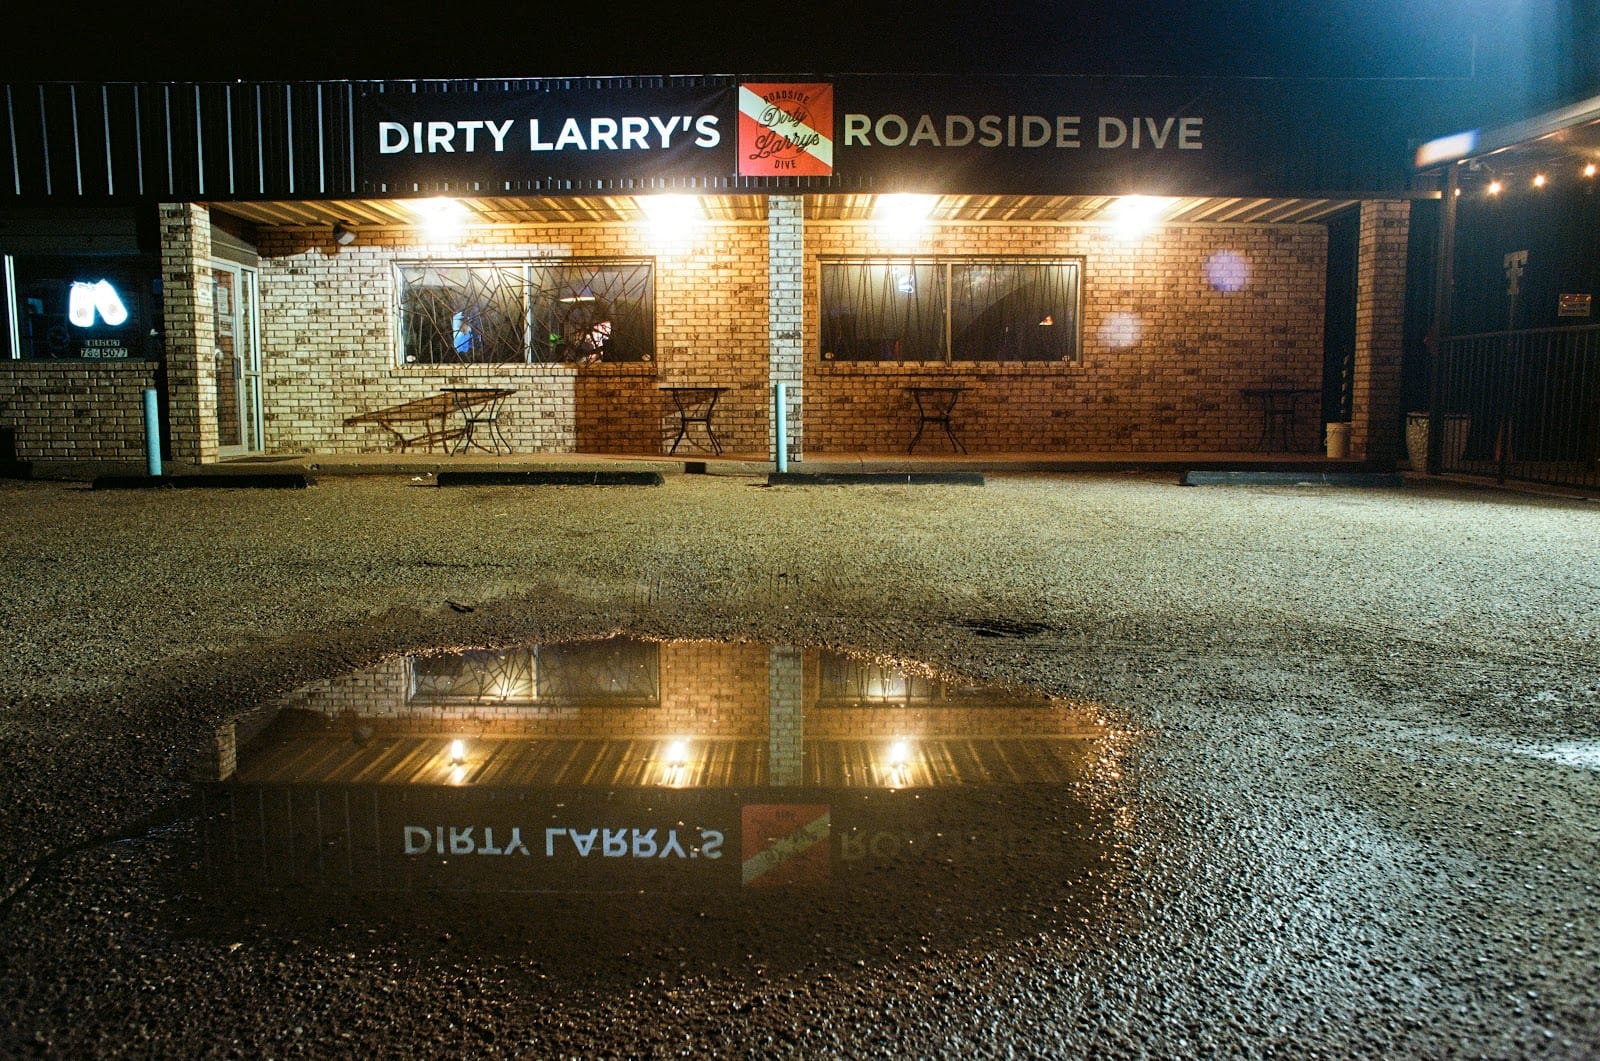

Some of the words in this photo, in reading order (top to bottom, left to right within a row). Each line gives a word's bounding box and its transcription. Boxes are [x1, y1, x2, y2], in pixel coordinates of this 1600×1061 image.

[763, 90, 810, 105] ROADSIDE
[759, 105, 807, 127] Dirty
[378, 119, 514, 155] DIRTY
[529, 115, 721, 152] LARRY'S
[844, 113, 1081, 148] ROADSIDE
[1098, 116, 1204, 150] DIVE
[774, 159, 797, 169] DIVE
